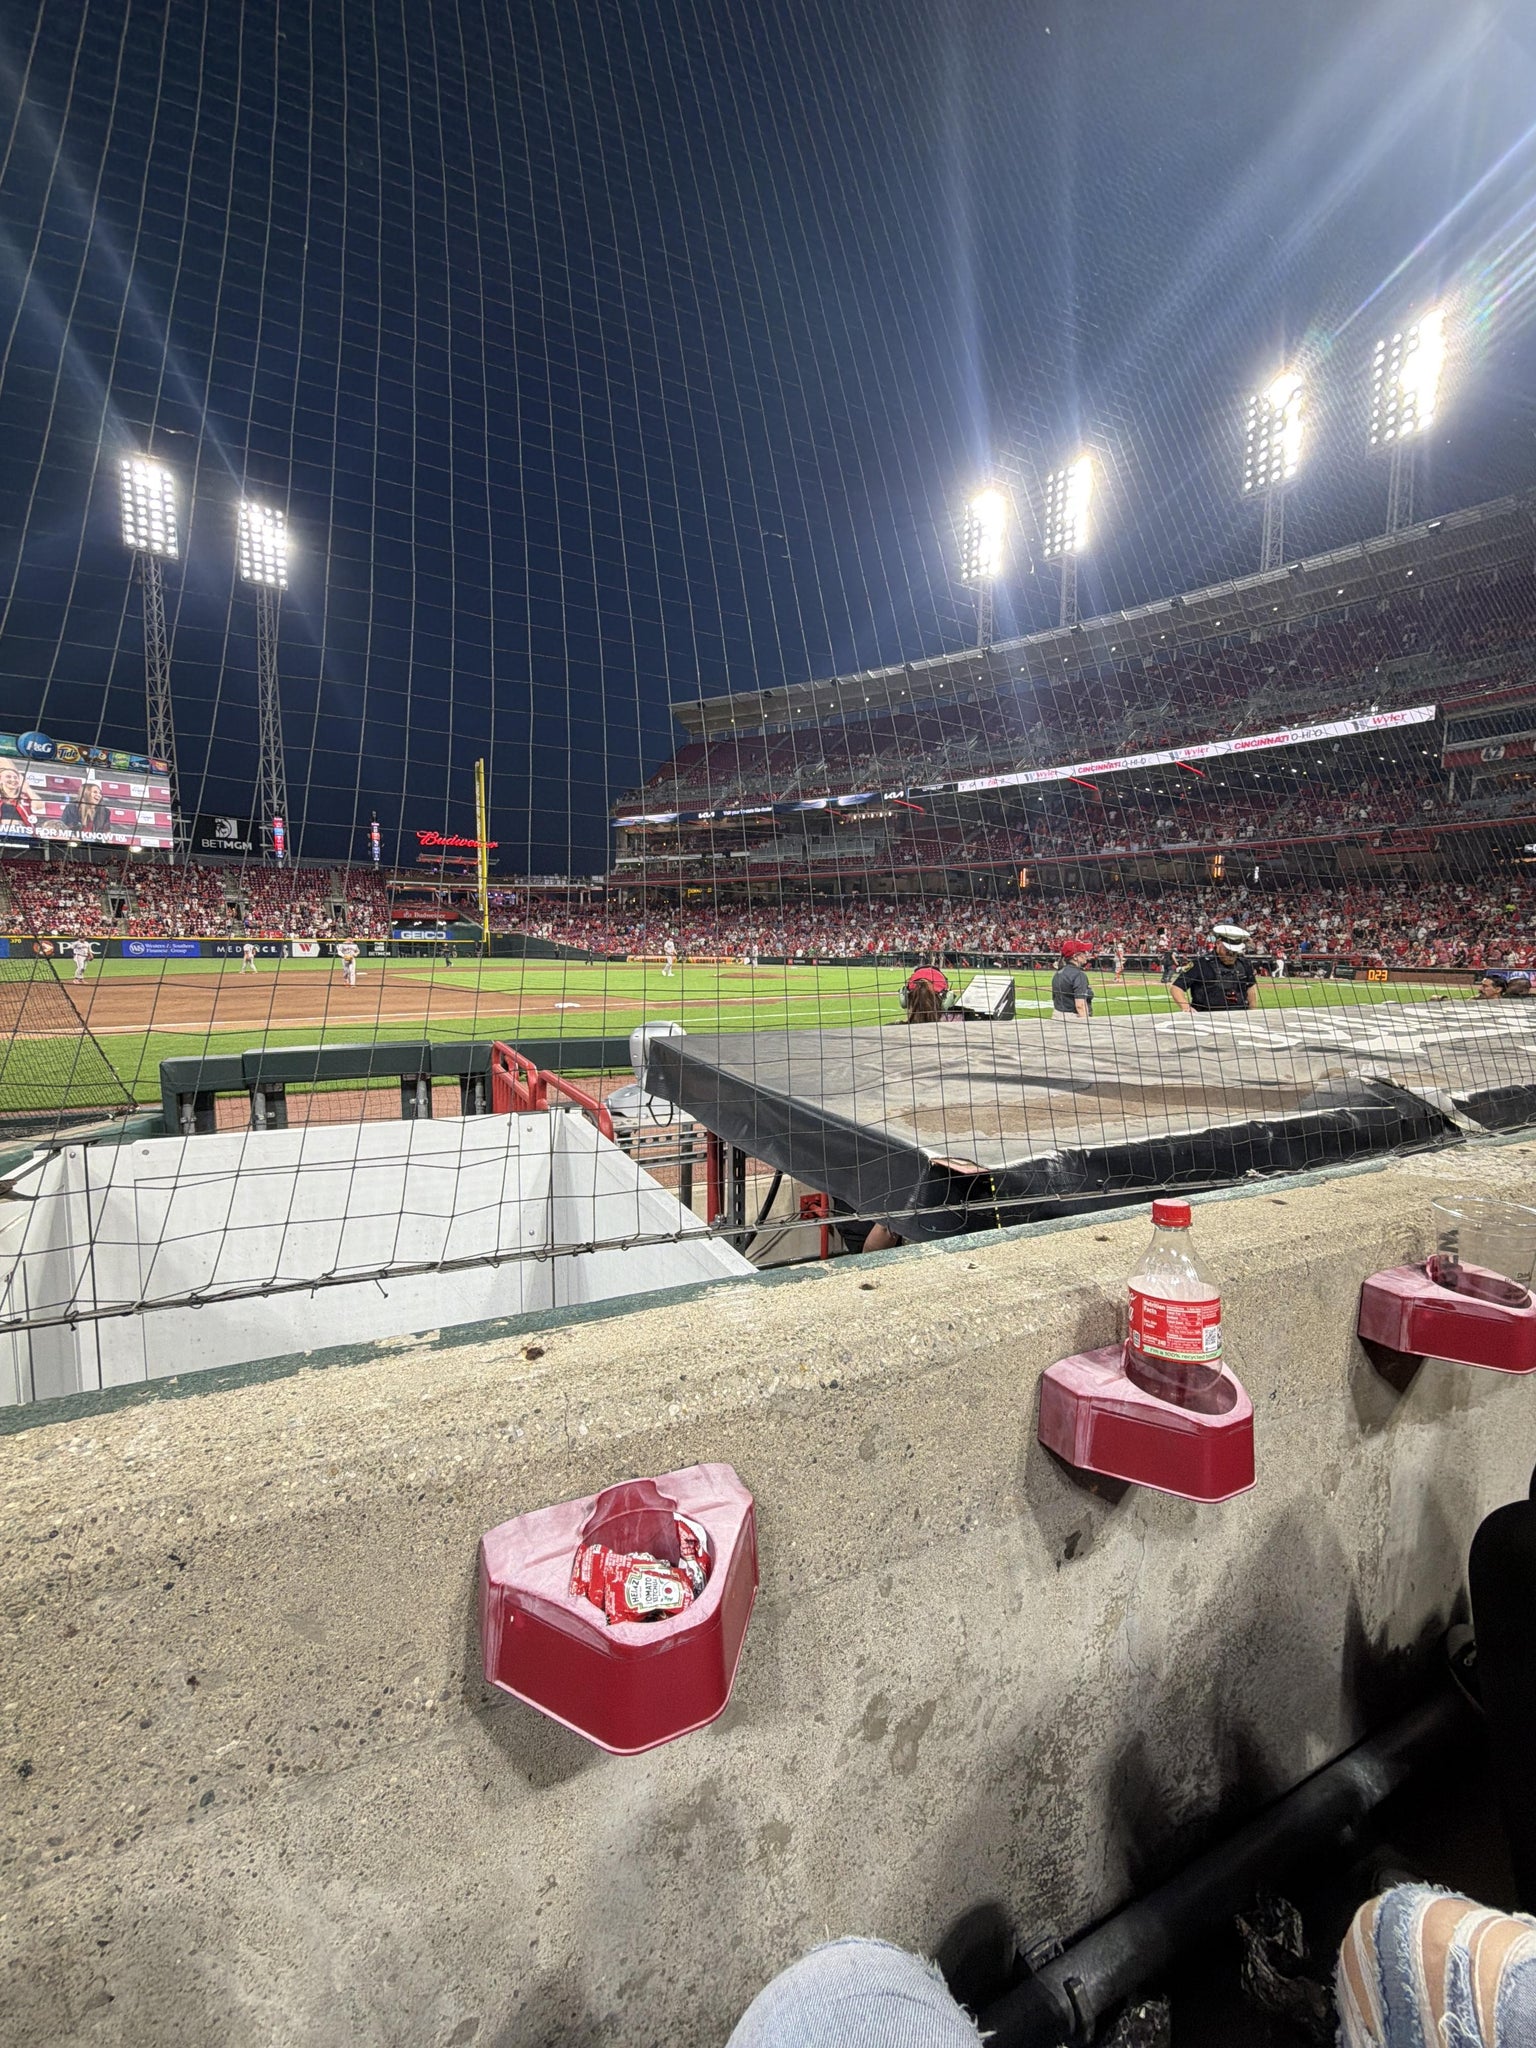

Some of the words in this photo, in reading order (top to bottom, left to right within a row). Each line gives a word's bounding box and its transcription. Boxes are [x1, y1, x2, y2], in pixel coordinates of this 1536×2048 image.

[1372, 712, 1407, 725] Wyler
[26, 740, 53, 753] P&G
[1234, 734, 1289, 750] CINCINNATI
[59, 748, 78, 759] Tide
[1077, 761, 1120, 774] CINCINNATI
[0, 824, 33, 835] WAITS
[36, 827, 59, 837] FOR
[81, 831, 113, 841] KNOW
[416, 830, 498, 848] Budweer
[201, 838, 253, 850] BETMGM
[414, 911, 446, 919] Budweiser
[400, 930, 447, 940] GEICO
[57, 941, 102, 955] PC
[216, 945, 277, 953] MEDCE
[1367, 969, 1388, 982] 023
[1143, 1300, 1166, 1311] Nutrition
[1143, 1305, 1157, 1315] Facts
